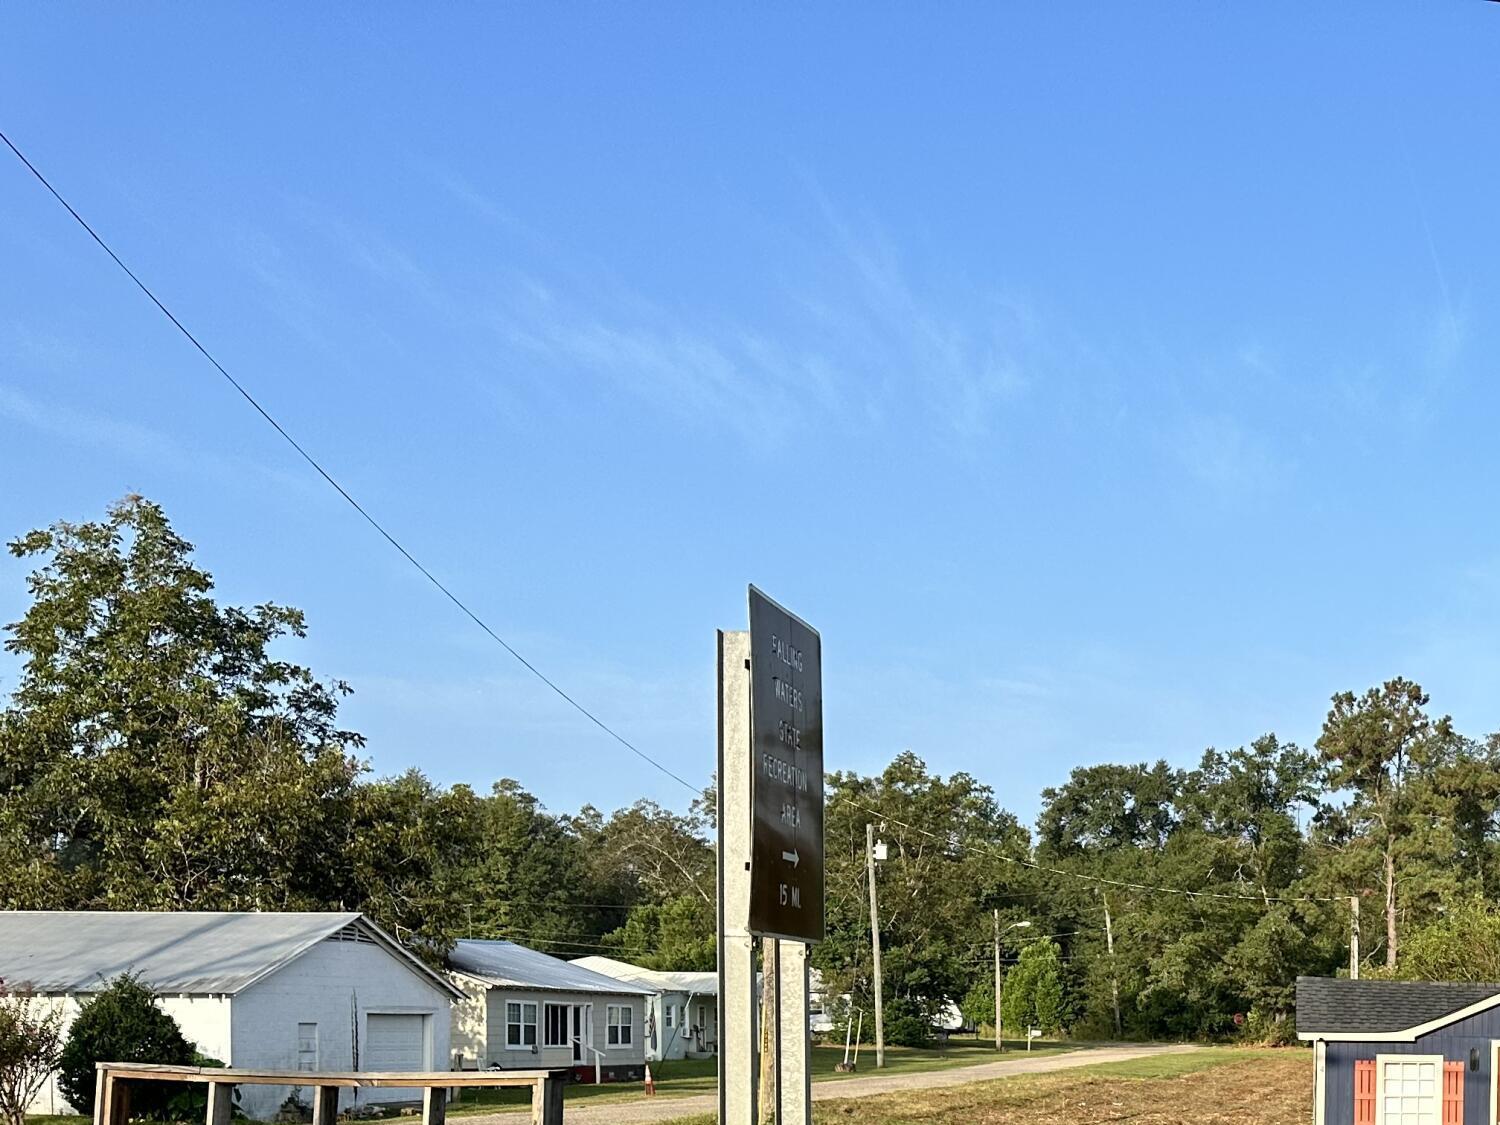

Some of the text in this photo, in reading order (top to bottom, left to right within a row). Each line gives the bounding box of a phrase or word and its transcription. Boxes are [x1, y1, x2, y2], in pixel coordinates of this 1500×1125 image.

[772, 635, 802, 672] FALLING
[775, 679, 802, 712] WATERS
[779, 720, 801, 750] STATE
[763, 752, 807, 792] RECREATION
[781, 803, 800, 828] AREA
[779, 883, 788, 906] 15
